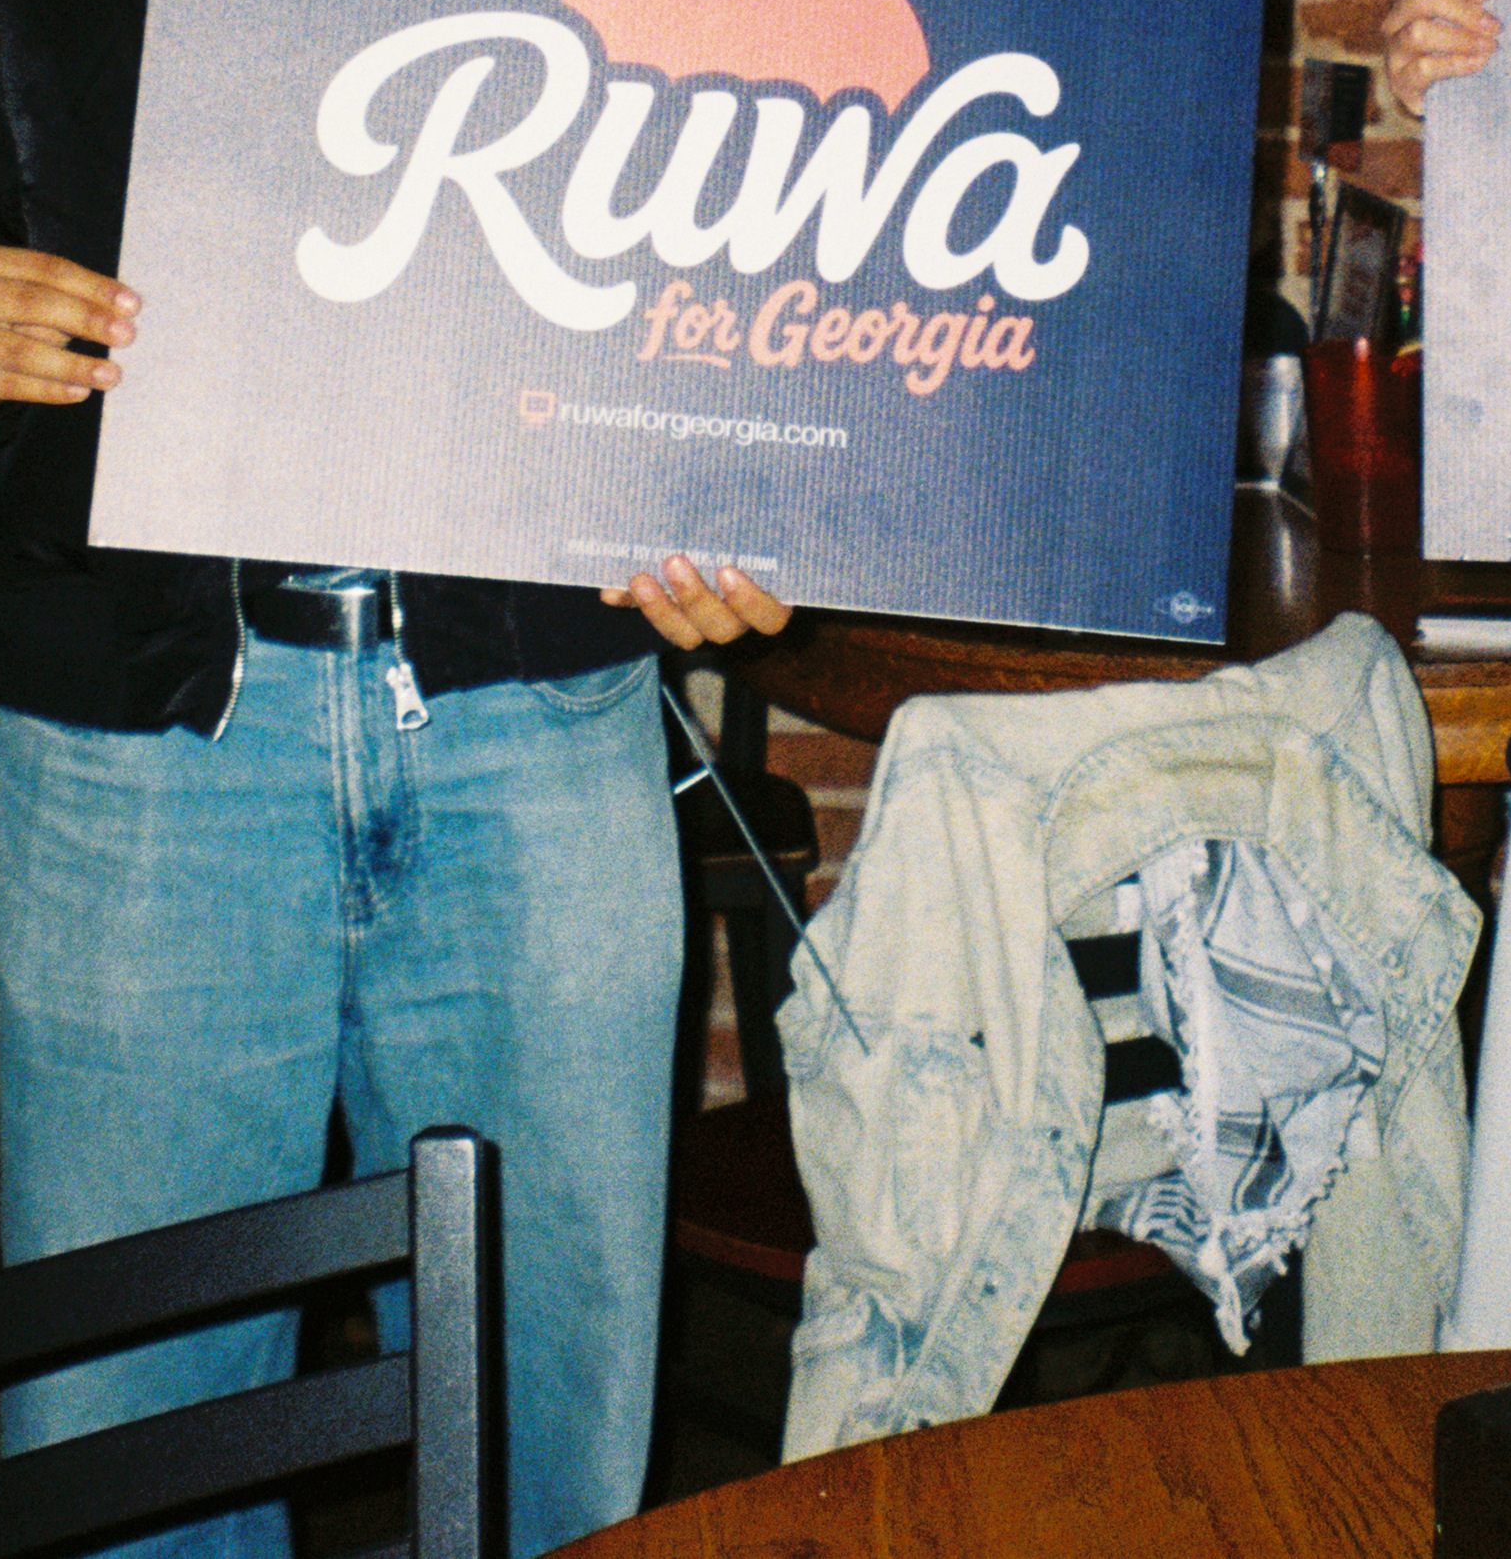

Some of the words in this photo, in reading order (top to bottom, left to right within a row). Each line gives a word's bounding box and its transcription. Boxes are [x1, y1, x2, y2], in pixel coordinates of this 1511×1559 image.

[294, 10, 1090, 331] Ruwa
[636, 279, 741, 367] for
[749, 279, 1036, 396] Georgia
[560, 402, 848, 449] ruwaforgeorgia.com
